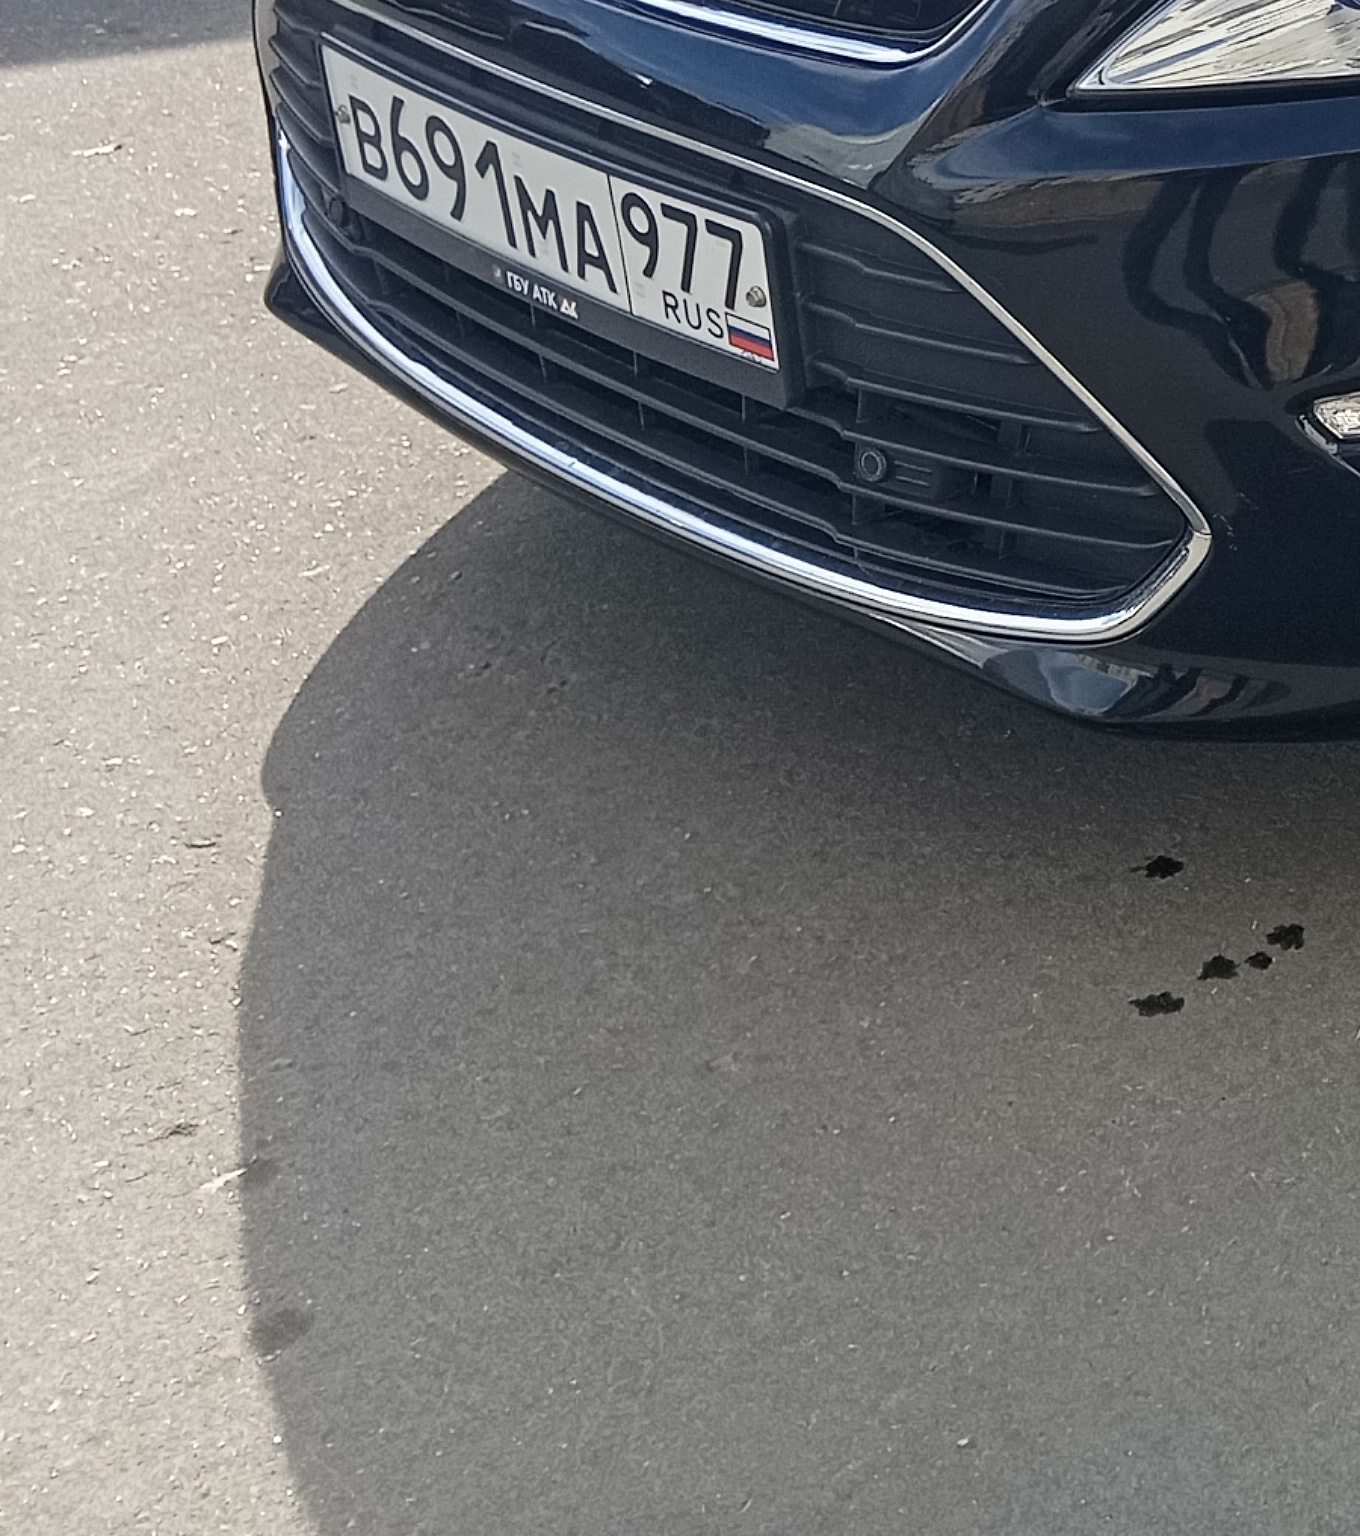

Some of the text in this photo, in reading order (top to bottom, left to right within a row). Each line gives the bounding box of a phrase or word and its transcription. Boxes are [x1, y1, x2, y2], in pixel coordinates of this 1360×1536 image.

[621, 191, 743, 311] 977
[506, 270, 530, 296] ГБУ
[533, 284, 558, 310] АТК
[662, 289, 725, 339] RUS
